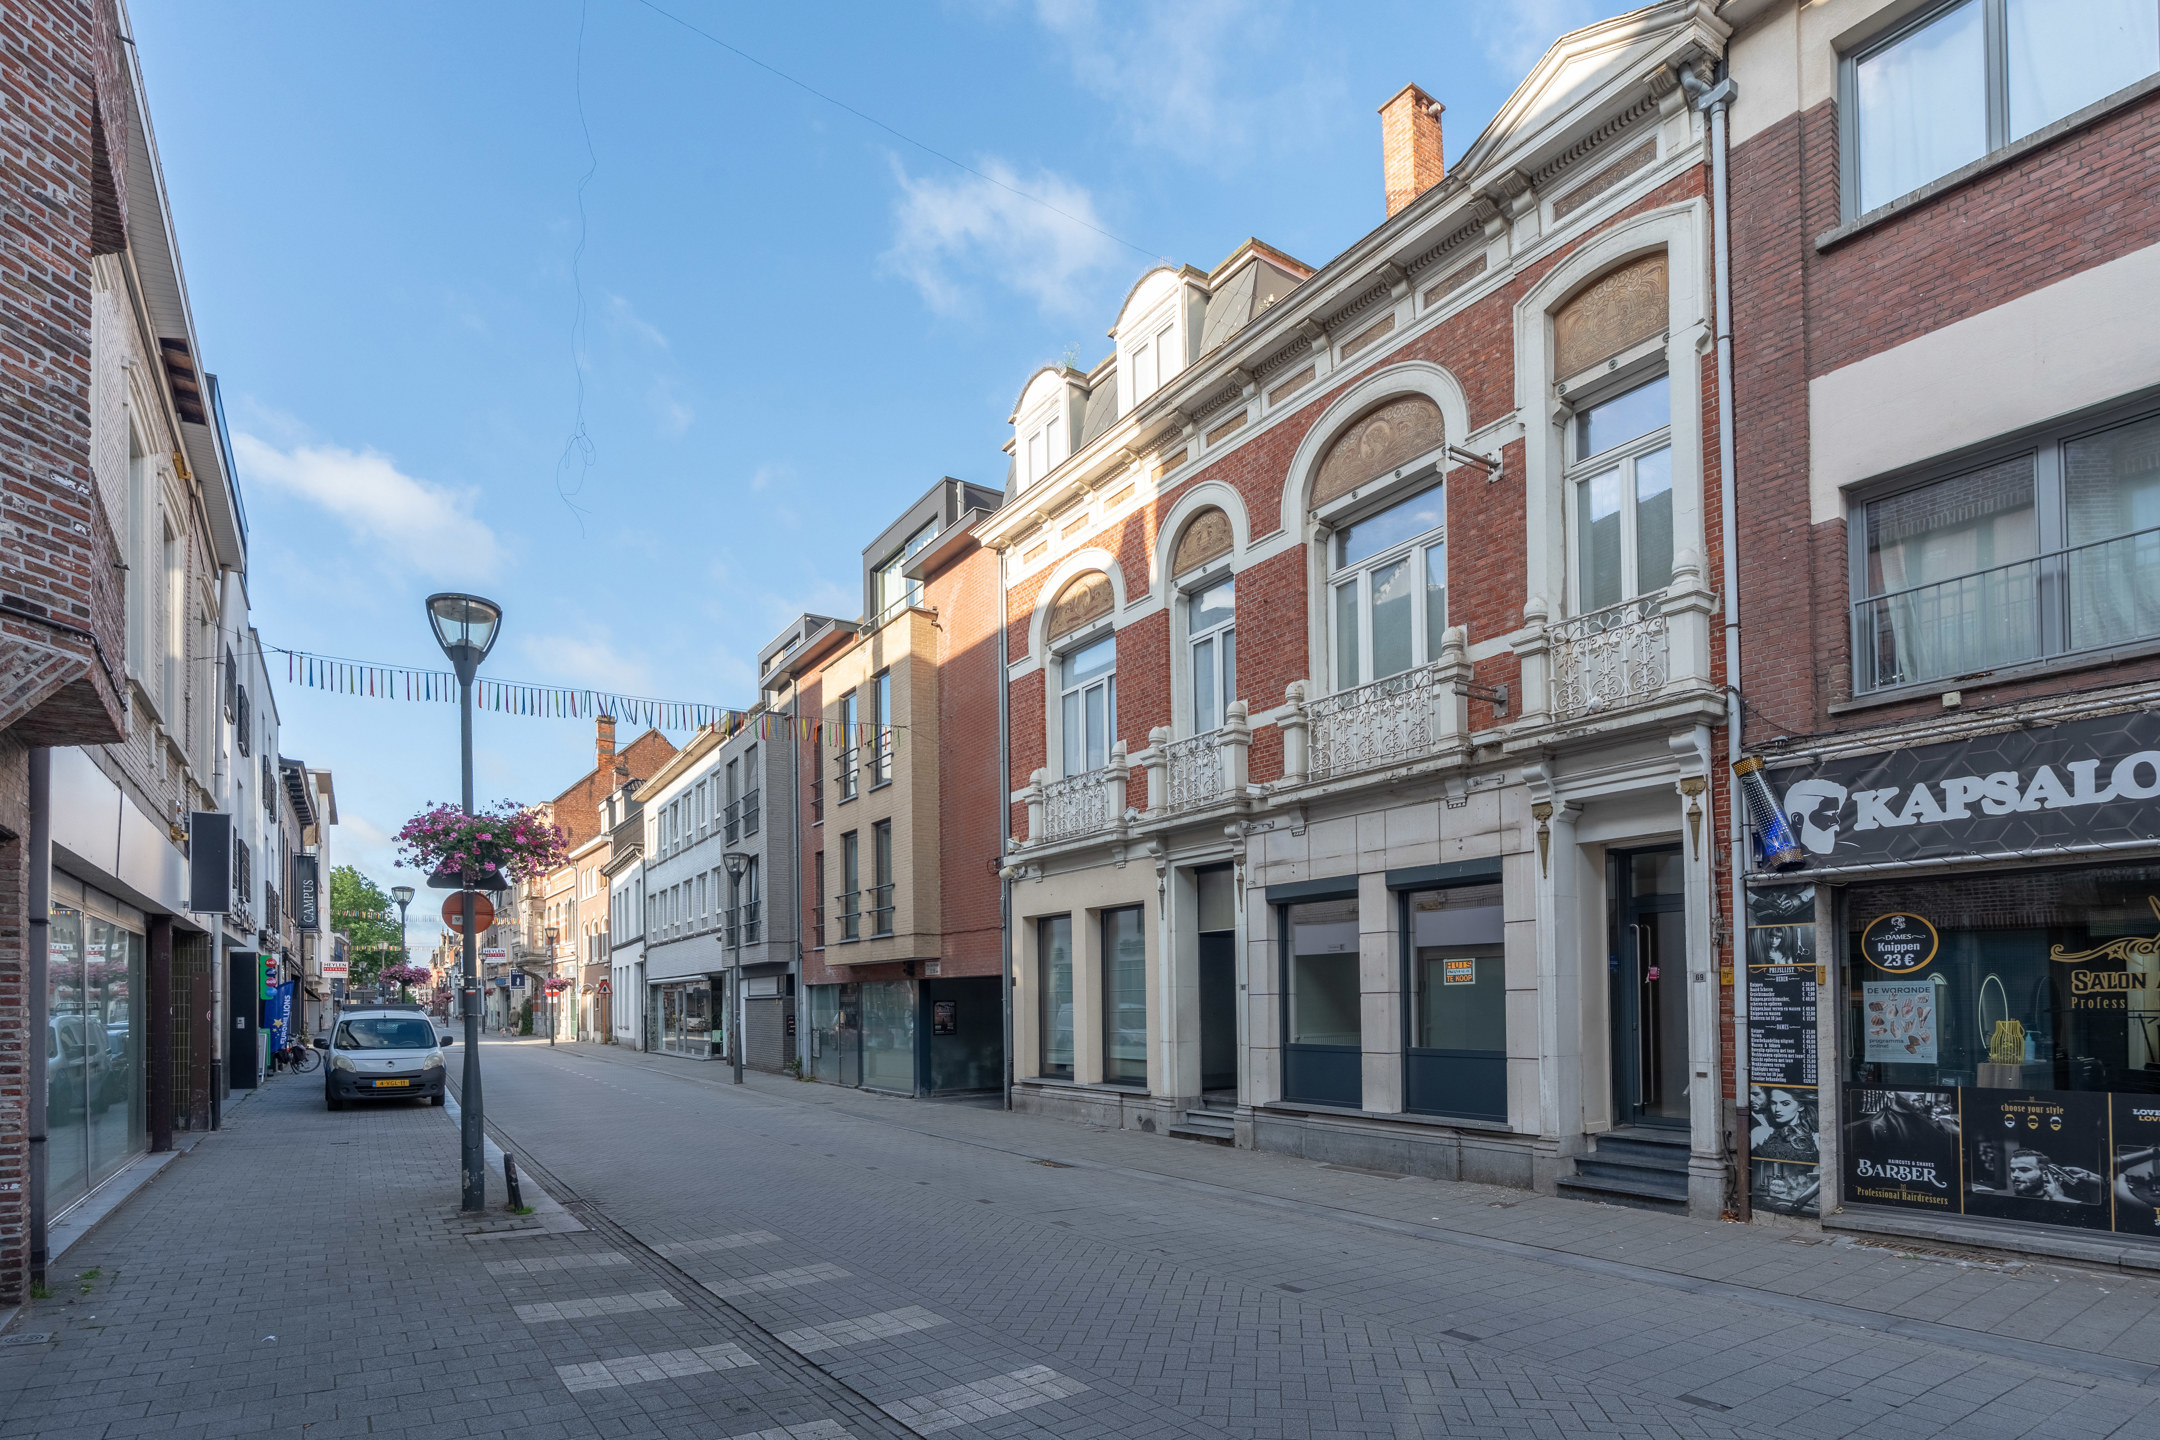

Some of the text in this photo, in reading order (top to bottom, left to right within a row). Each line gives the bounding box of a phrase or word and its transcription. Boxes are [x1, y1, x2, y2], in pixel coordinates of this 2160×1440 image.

[1852, 751, 2160, 831] KAPSALO
[303, 880, 314, 922] CAMPUS
[1878, 942, 1920, 953] Knippen
[1884, 953, 1914, 966] 23 €
[2071, 970, 2147, 994] SALON
[280, 995, 291, 1044] EUROMILLIONS
[2000, 1103, 2026, 1112] choose
[2046, 1106, 2064, 1115] style
[1857, 1159, 1947, 1188] BARBER
[1857, 1186, 1948, 1205] Professional Hairdressers
